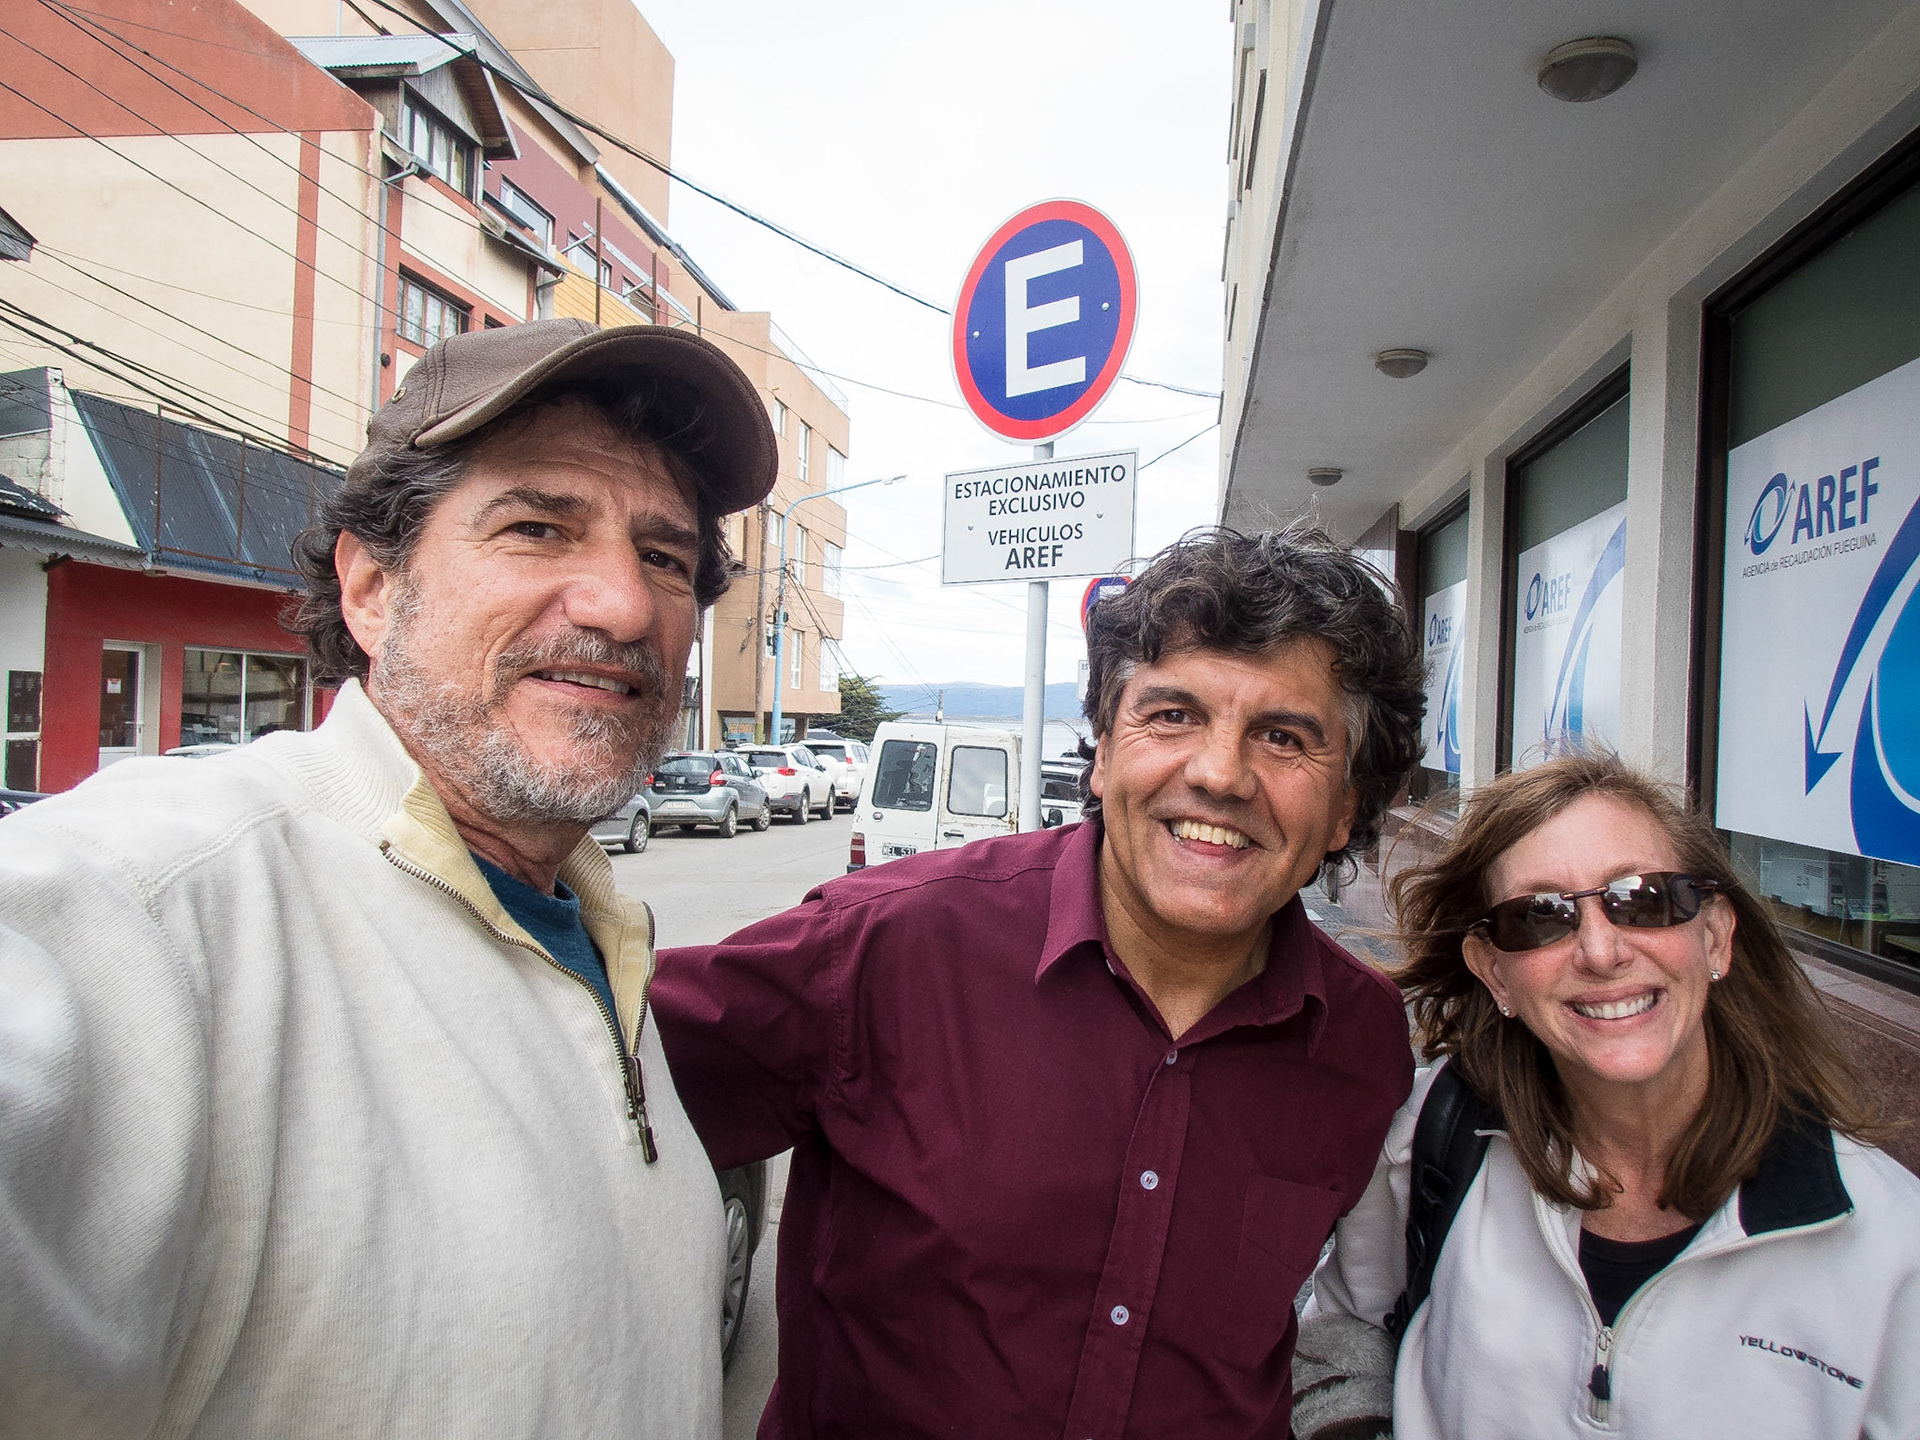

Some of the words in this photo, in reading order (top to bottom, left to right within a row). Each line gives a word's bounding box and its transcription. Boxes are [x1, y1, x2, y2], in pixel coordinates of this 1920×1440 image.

[1004, 239, 1086, 398] E
[955, 464, 1126, 499] ESTACIONAMIENTO
[1791, 456, 1880, 545] AREF
[988, 491, 1085, 516] EXCLUSIVO
[988, 523, 1083, 546] VEHICULOS
[1742, 562, 1770, 579] AGENCIA
[1770, 560, 1779, 572] de
[1779, 543, 1832, 570] RECAUDACIÓN
[1833, 532, 1877, 556] FUEGUINA
[1005, 544, 1064, 570] AREF
[1541, 573, 1571, 616] AREF
[1739, 1335, 1864, 1389] YELLOWSTONE
